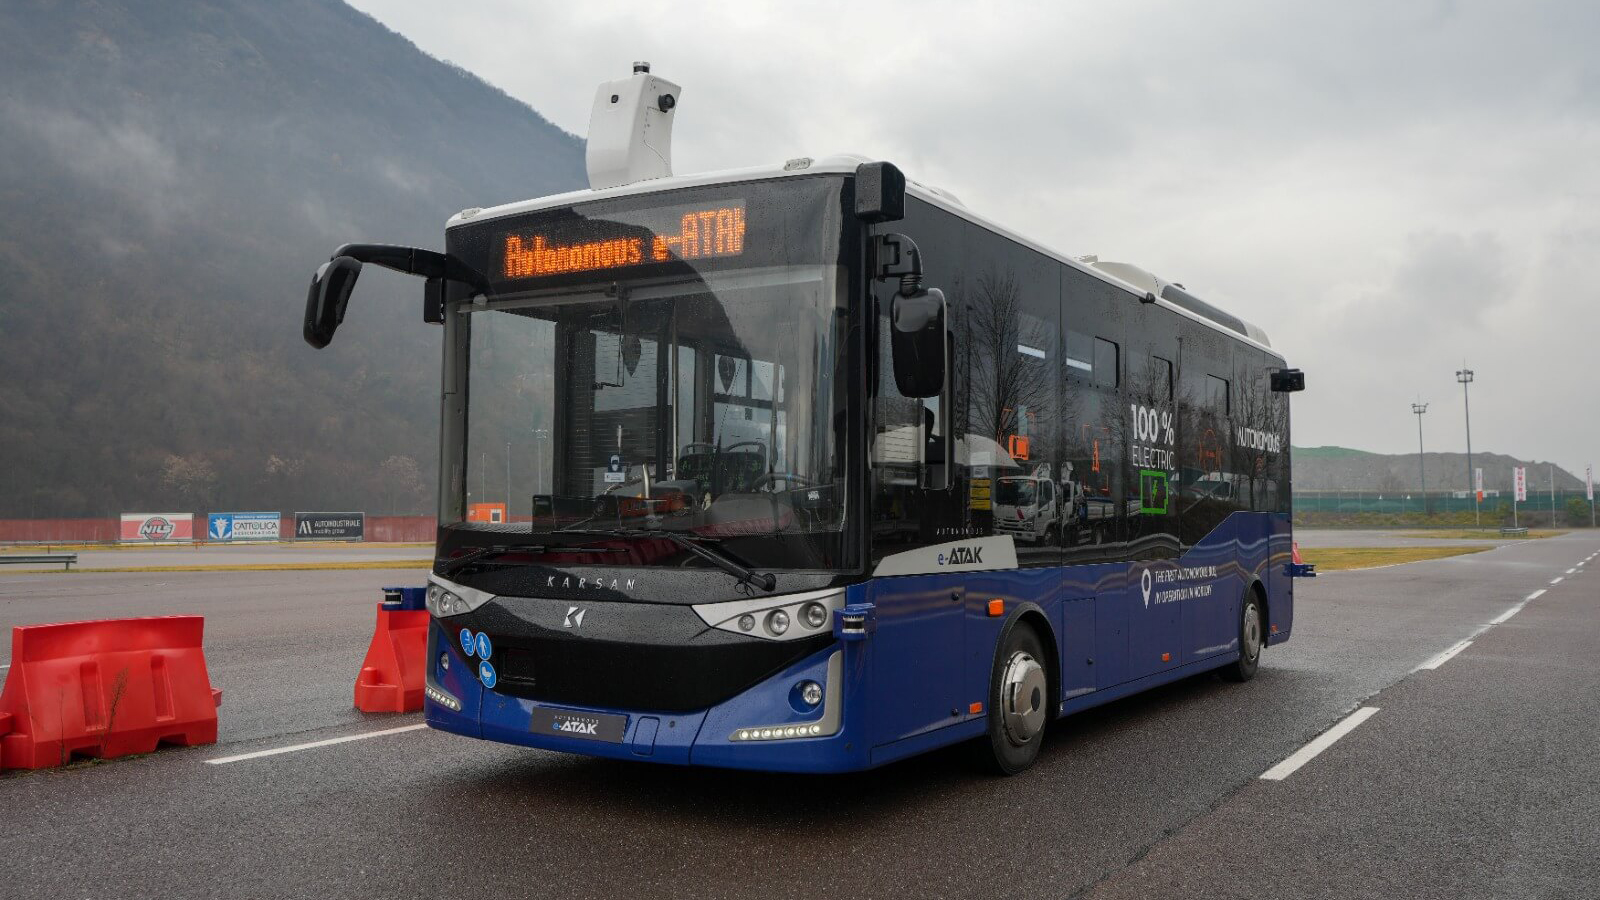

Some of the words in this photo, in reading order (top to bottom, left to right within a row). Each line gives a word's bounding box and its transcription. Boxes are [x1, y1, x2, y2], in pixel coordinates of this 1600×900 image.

[505, 234, 642, 277] Autonomous
[1131, 404, 1159, 443] 100
[1162, 411, 1175, 446] %
[1132, 445, 1175, 471] ELECTRIC
[140, 524, 173, 535] NILS
[233, 521, 278, 530] CATTOLICA
[314, 519, 361, 528] AUTOINDUSTRIALE
[938, 546, 983, 566] e-ATAK
[547, 576, 635, 590] KARSAN
[552, 720, 598, 735] e-ATAK
